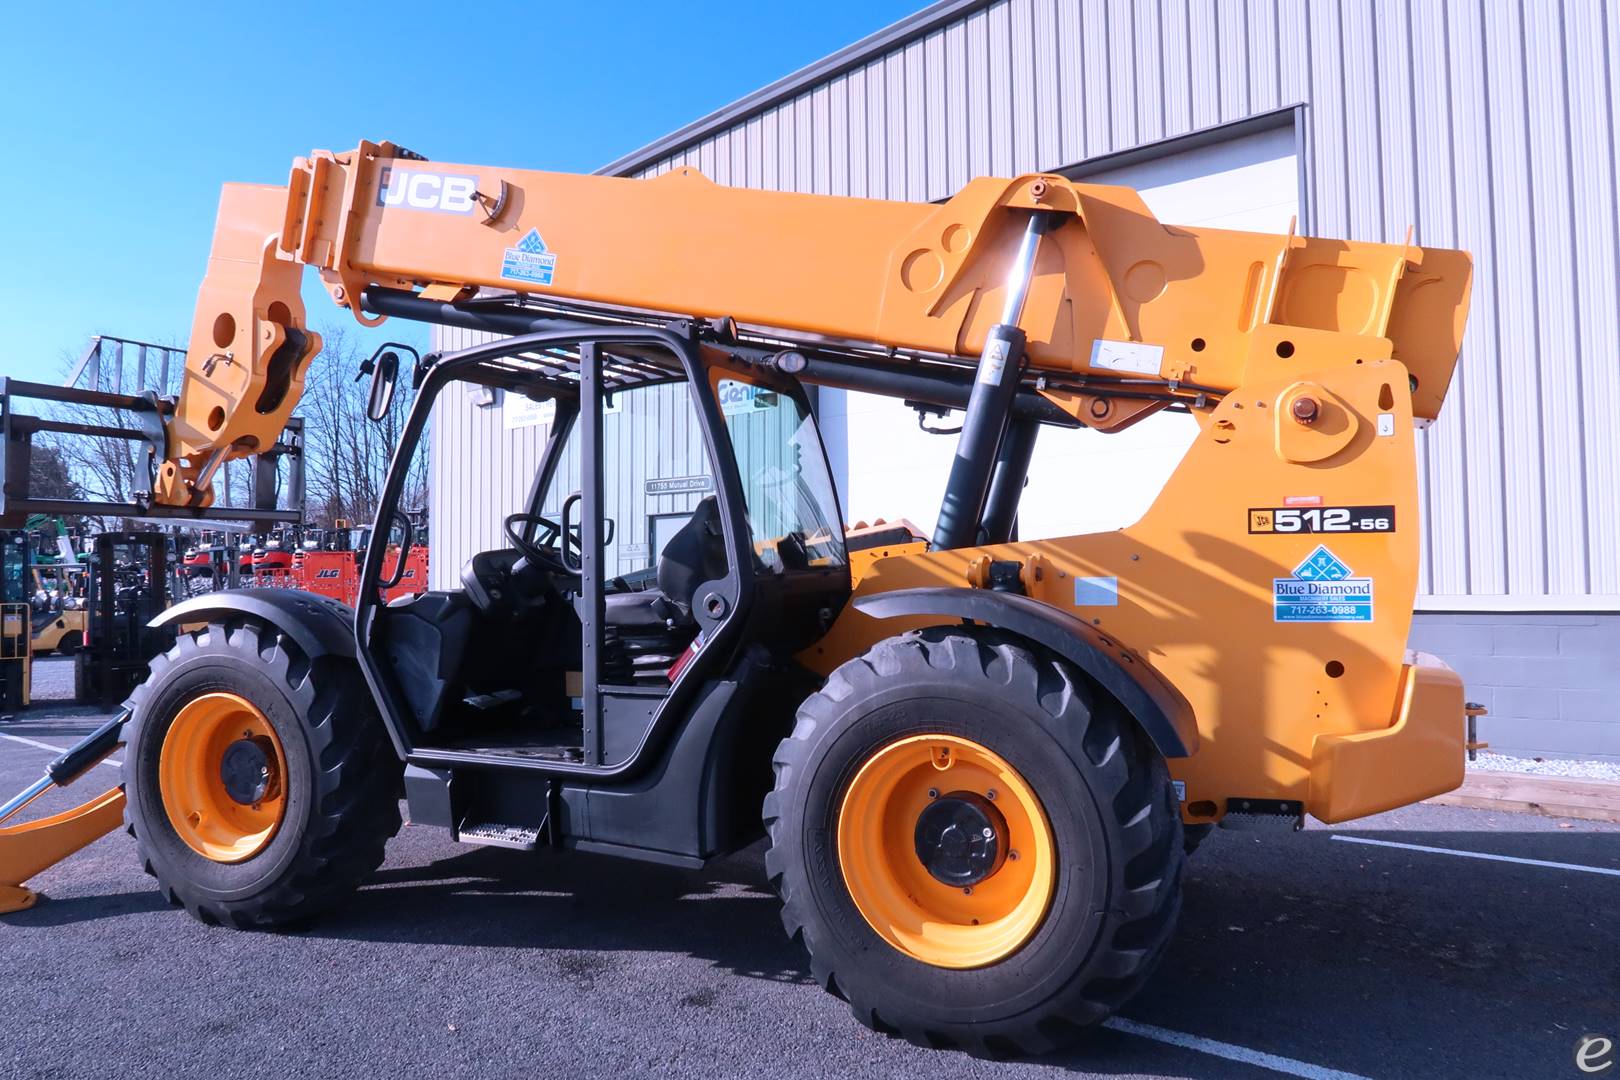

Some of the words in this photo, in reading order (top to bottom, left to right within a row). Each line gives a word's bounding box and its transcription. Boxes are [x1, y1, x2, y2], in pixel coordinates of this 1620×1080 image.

[380, 172, 475, 212] JCB
[505, 251, 521, 262] Blue
[521, 253, 555, 266] Diamond
[669, 480, 688, 489] Mutual
[689, 479, 705, 488] Drive
[1275, 509, 1389, 532] 512-56
[316, 569, 339, 578] JLG
[1276, 583, 1305, 595] Blue
[1308, 583, 1370, 595] Diamond
[1290, 606, 1357, 615] 717-263-0988
